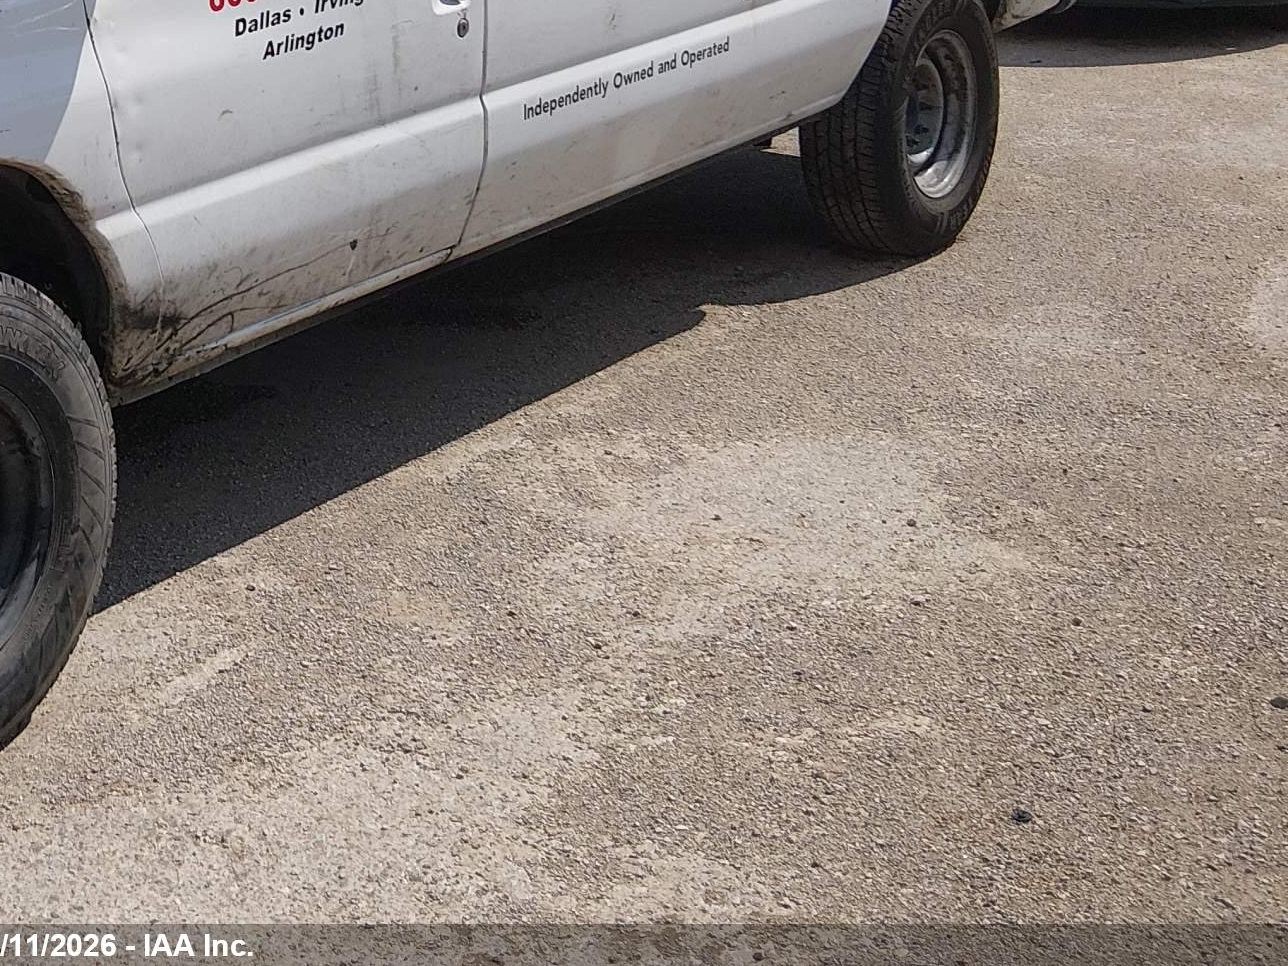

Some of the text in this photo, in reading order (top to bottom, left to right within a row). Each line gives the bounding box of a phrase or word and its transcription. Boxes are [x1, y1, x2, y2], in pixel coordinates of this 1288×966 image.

[235, 8, 292, 37] Dallas
[262, 22, 345, 60] Arlington
[523, 36, 730, 121] Independently Owned and Operated
